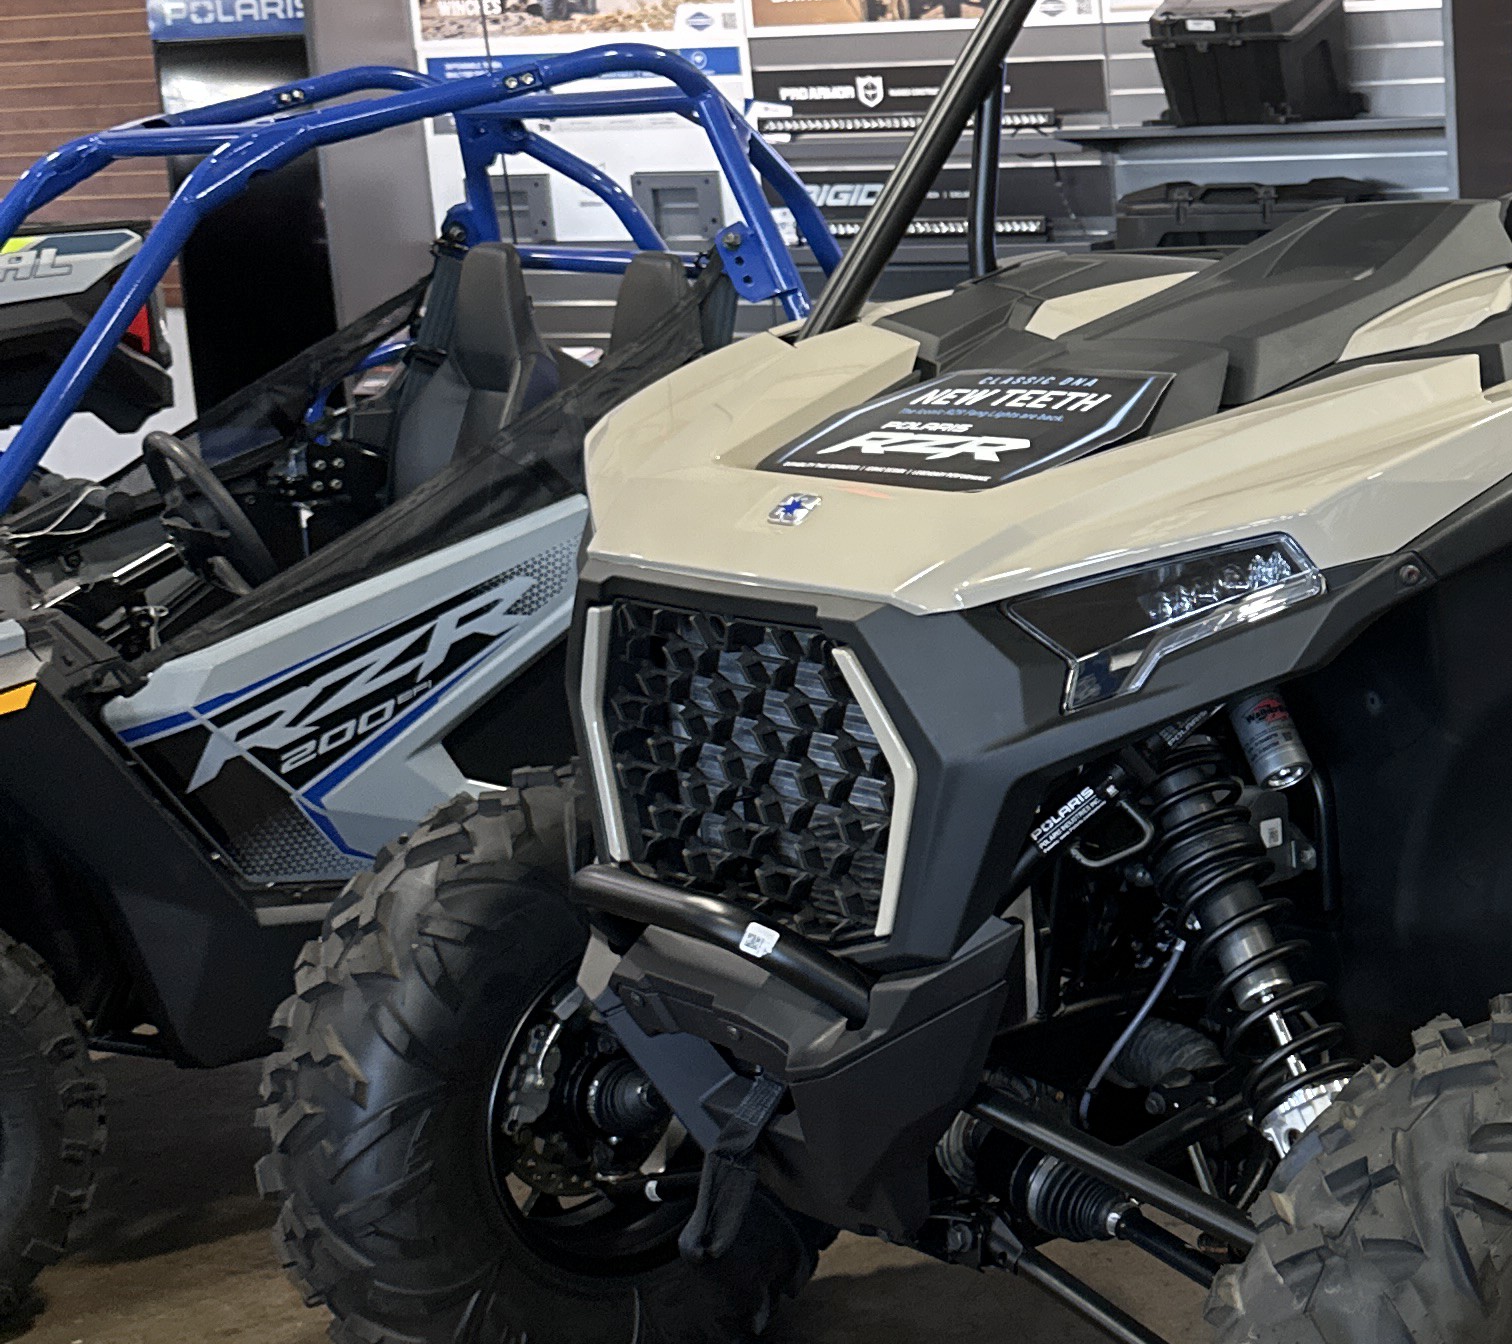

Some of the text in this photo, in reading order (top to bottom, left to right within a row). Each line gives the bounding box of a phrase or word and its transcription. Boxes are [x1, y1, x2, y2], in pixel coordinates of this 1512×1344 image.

[779, 86, 855, 100] PRO ARMOR
[978, 376, 1099, 388] CLASSIC DNA
[909, 389, 1112, 412] NEW TEETH
[881, 421, 974, 433] POLARIS
[817, 431, 1031, 463] RZR
[187, 575, 539, 793] RZR
[280, 698, 396, 775] 200
[1031, 786, 1094, 841] POLARIS
